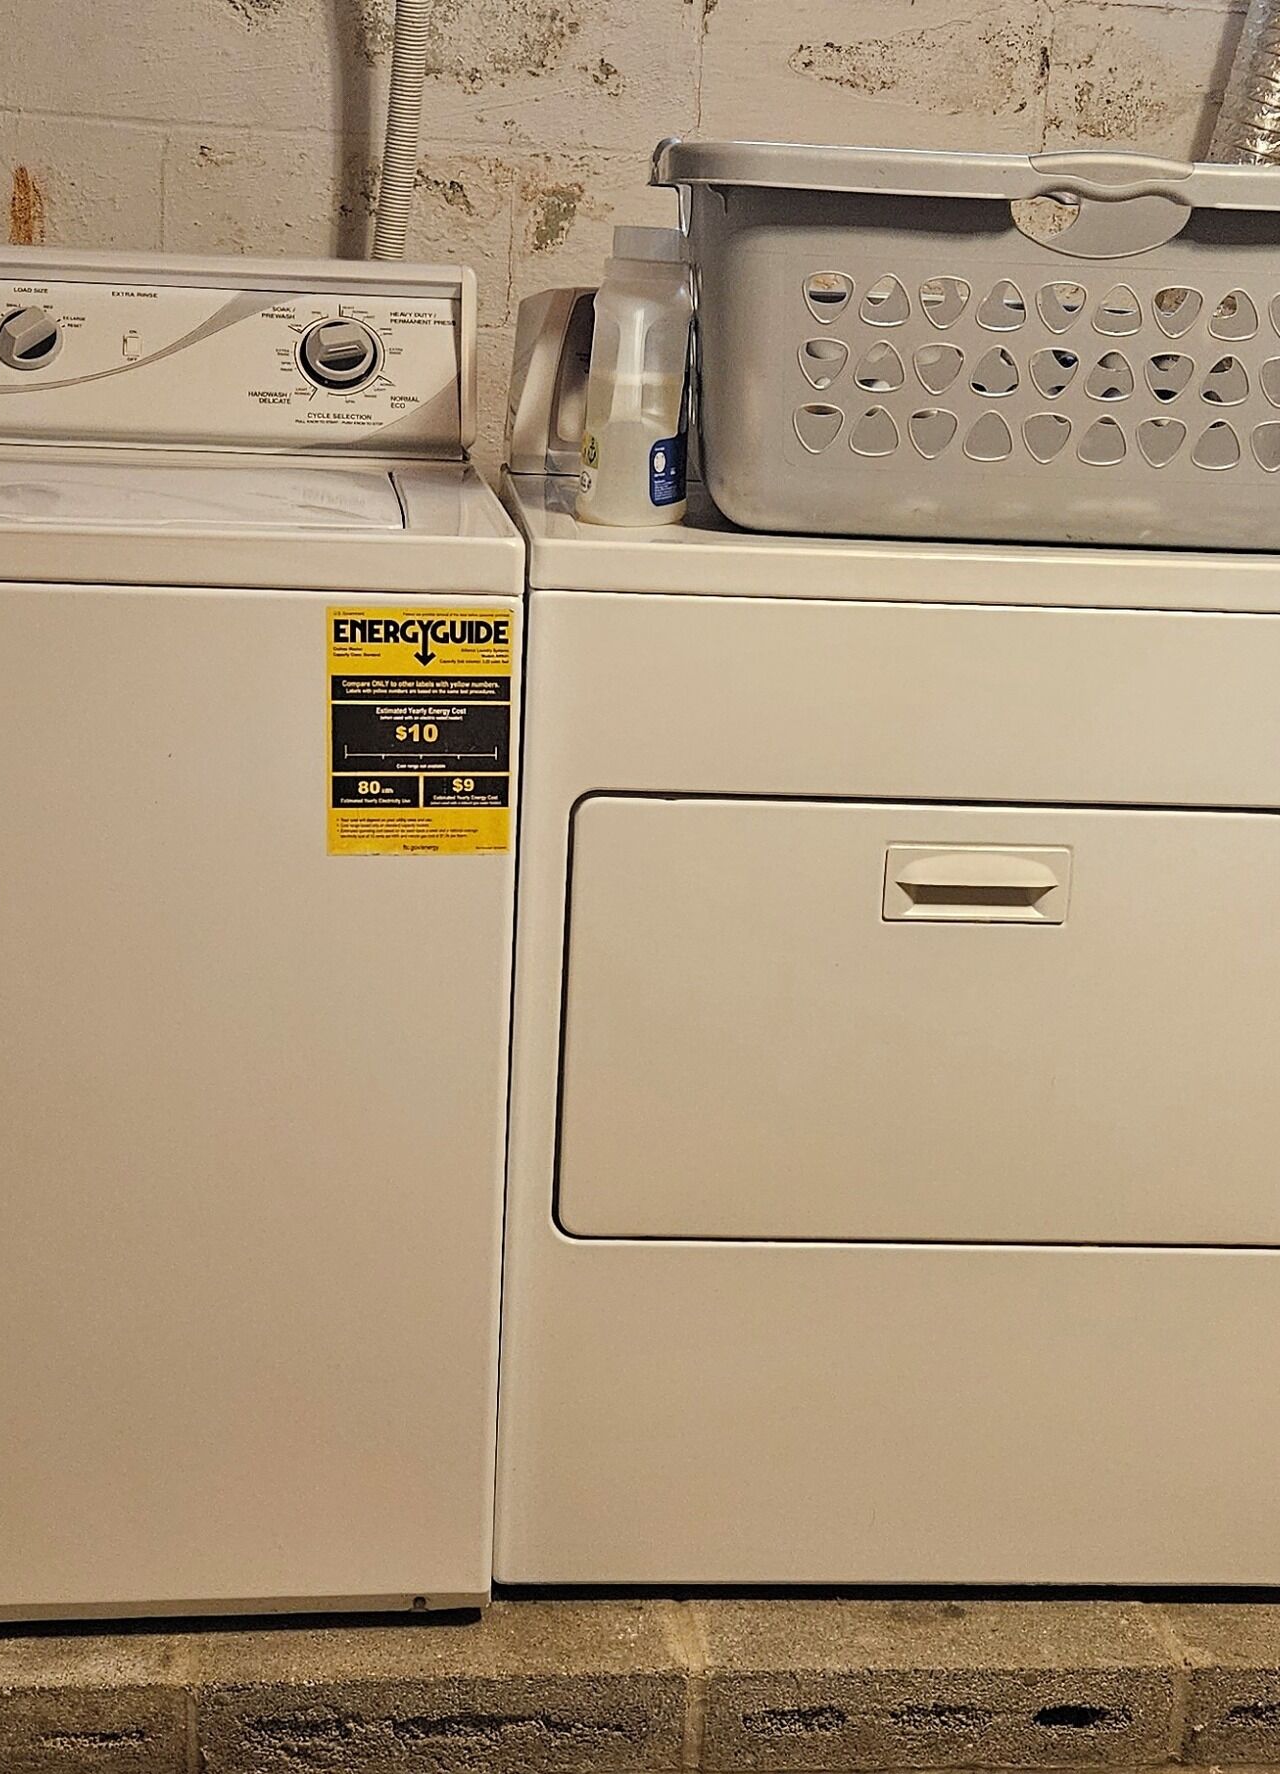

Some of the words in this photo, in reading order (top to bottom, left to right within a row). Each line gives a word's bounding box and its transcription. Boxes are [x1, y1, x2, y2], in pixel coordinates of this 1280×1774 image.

[261, 312, 296, 320] PREWASH
[389, 311, 413, 319] HEAVY
[389, 318, 432, 326] PERMANENT
[248, 391, 287, 399] HANDWASH
[307, 412, 331, 420] CYCLE
[332, 413, 372, 421] SELECTION
[334, 619, 509, 644] ENERGYGUIDE
[342, 680, 371, 688] Compare
[371, 680, 390, 688] ONLY
[390, 680, 397, 688] to
[398, 680, 415, 688] other
[450, 681, 470, 689] yellow
[375, 707, 407, 715] Estimated
[408, 707, 427, 716] Yearly
[428, 708, 450, 716] Energy
[396, 724, 438, 743] $10
[358, 781, 381, 795] 80
[452, 778, 475, 793] $9
